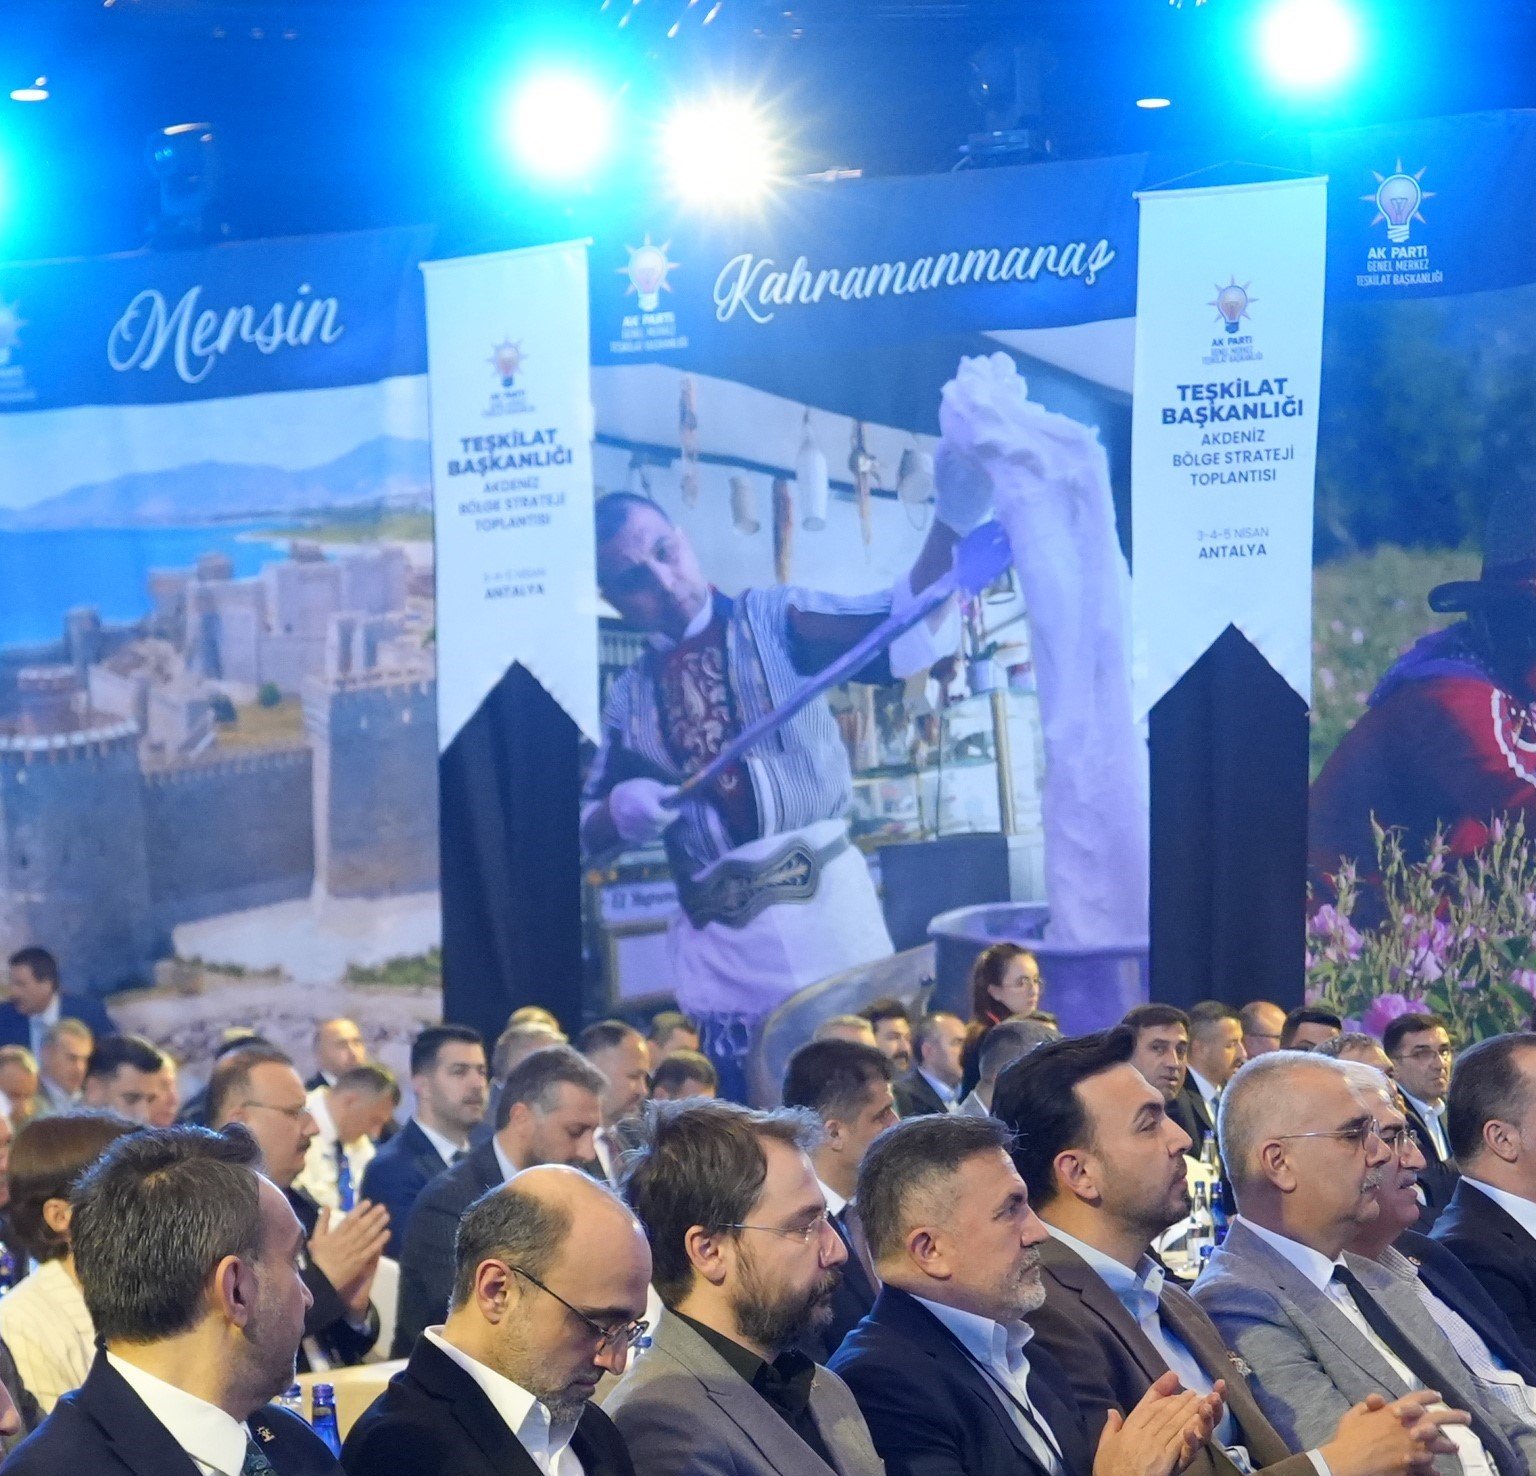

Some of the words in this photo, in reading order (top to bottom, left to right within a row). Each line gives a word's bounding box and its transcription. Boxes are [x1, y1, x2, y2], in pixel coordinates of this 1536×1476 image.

[1367, 247, 1387, 259] AK
[712, 238, 1115, 324] Kahramanmaraş
[107, 283, 344, 384] Mersin
[1177, 378, 1288, 405] TEŞKİLAT
[1162, 395, 1303, 428] BAŞKANLIĞI
[460, 428, 557, 453] TEŞKİLAT
[1201, 427, 1265, 446] AKDENİZ
[447, 444, 572, 477] BAŞKANLIĞI
[1172, 451, 1220, 467] BÖLGE
[1224, 444, 1294, 464] STRATEJİ
[1190, 468, 1276, 486] TOPLANTISI
[1197, 528, 1231, 541] 3-4-5
[1198, 544, 1267, 559] ANTALYA
